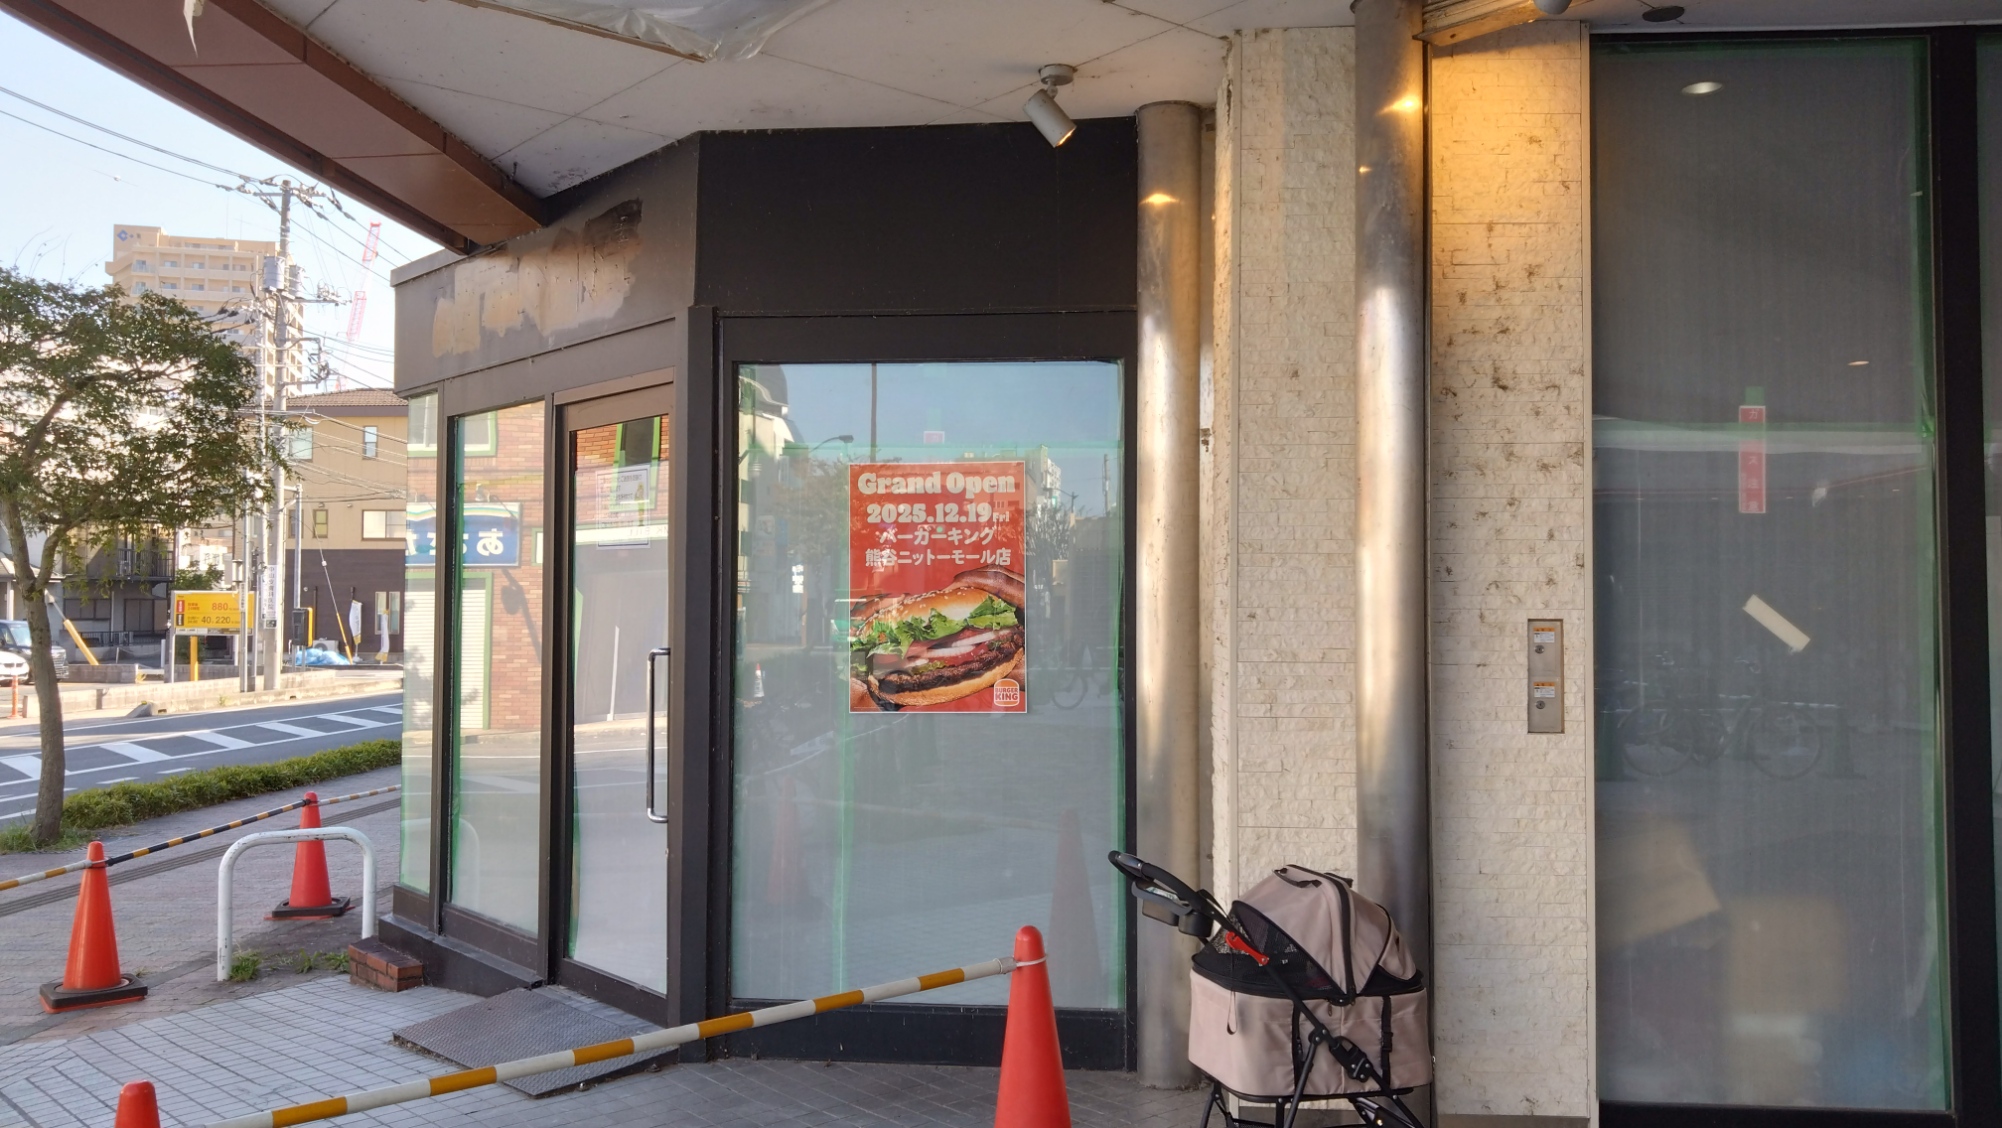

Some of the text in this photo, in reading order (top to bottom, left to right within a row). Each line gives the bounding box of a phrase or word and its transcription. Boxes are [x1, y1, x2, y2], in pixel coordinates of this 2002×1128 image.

[858, 471, 1015, 499] Grand Open
[866, 503, 1010, 524] 2025.12.19 Fri
[879, 526, 998, 546] バーガーキング
[865, 547, 1012, 567] 熊谷ニットーモール店
